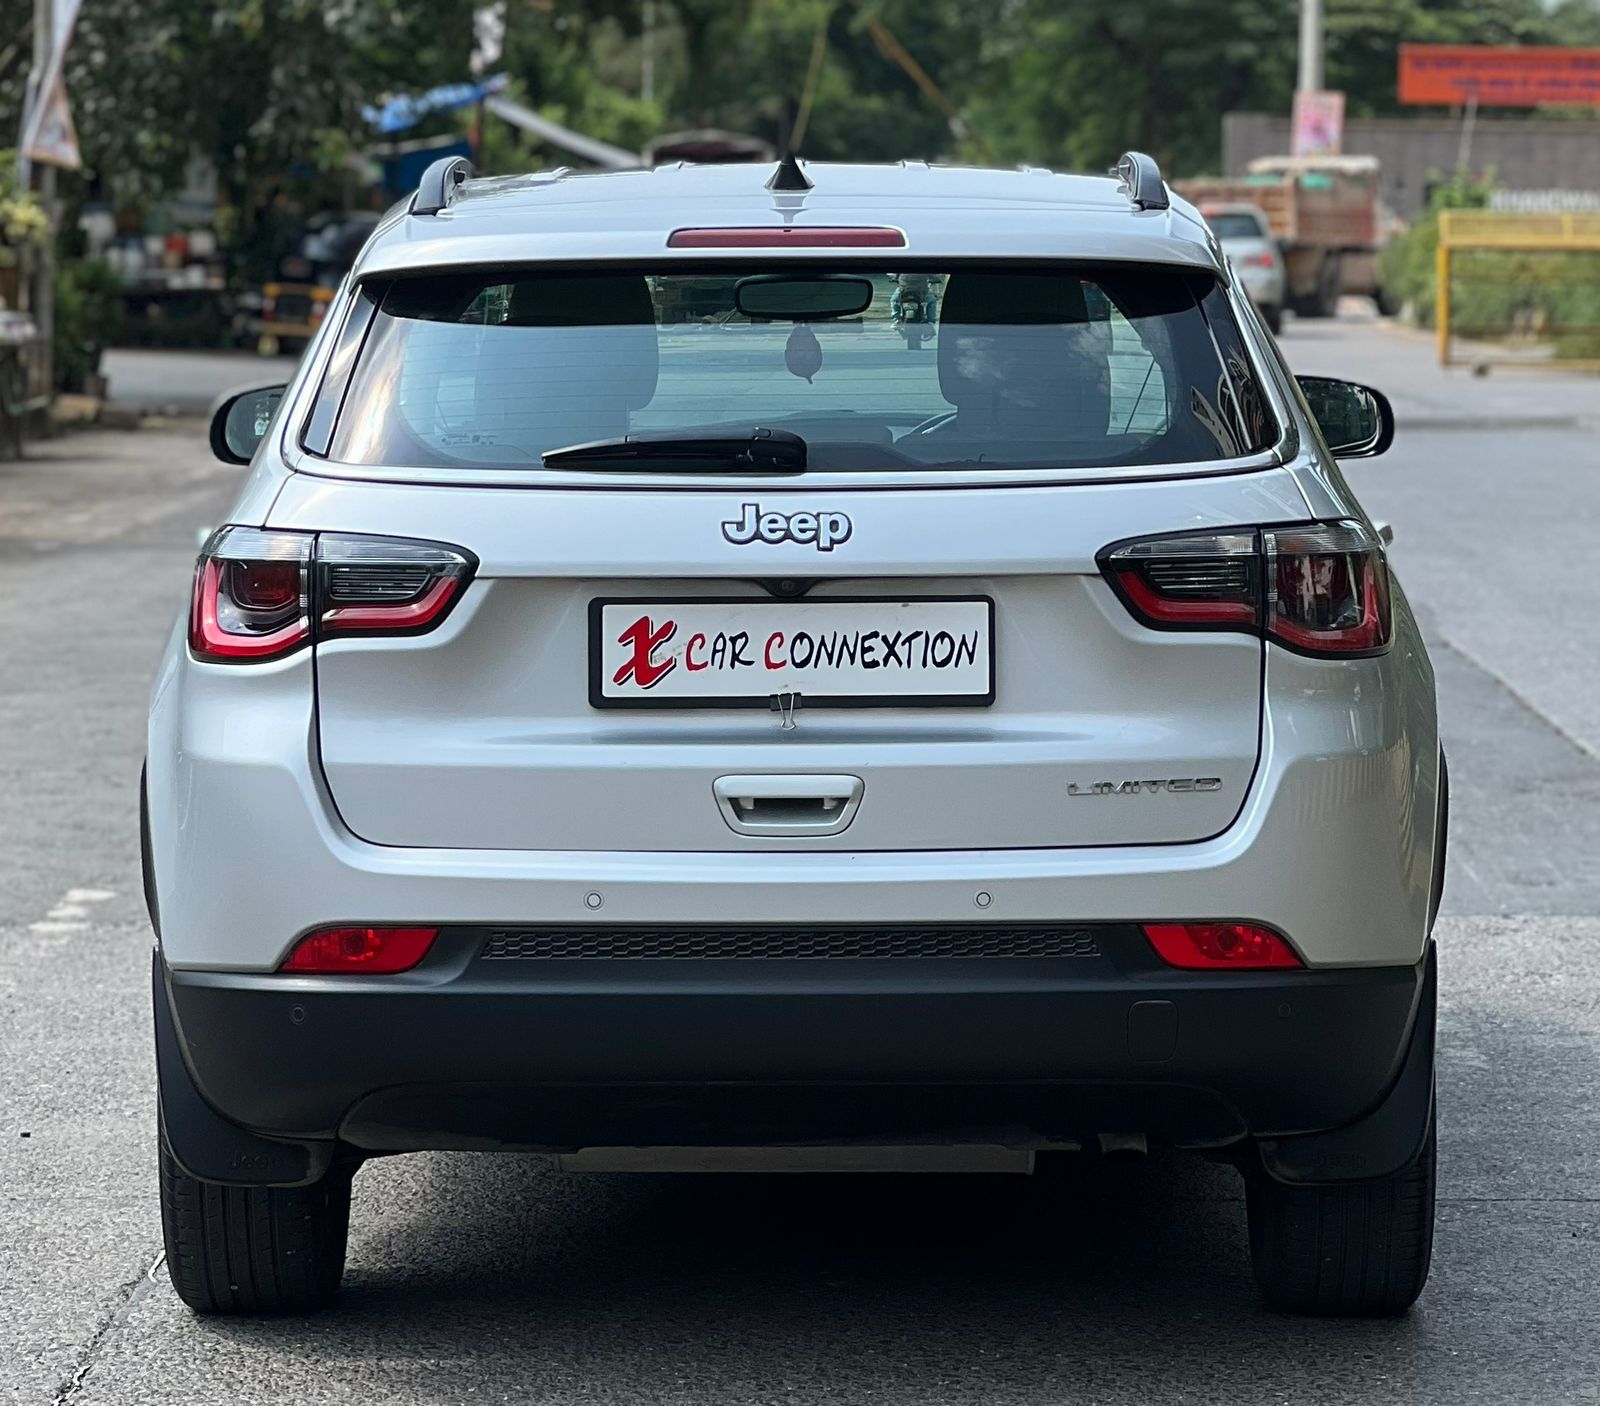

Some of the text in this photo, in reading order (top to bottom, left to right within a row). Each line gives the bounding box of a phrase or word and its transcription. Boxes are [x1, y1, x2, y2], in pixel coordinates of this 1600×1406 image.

[722, 503, 852, 552] Jeep
[685, 632, 754, 672] CAR
[764, 630, 978, 672] CONNEXTION
[1067, 777, 1222, 796] LIMITED
